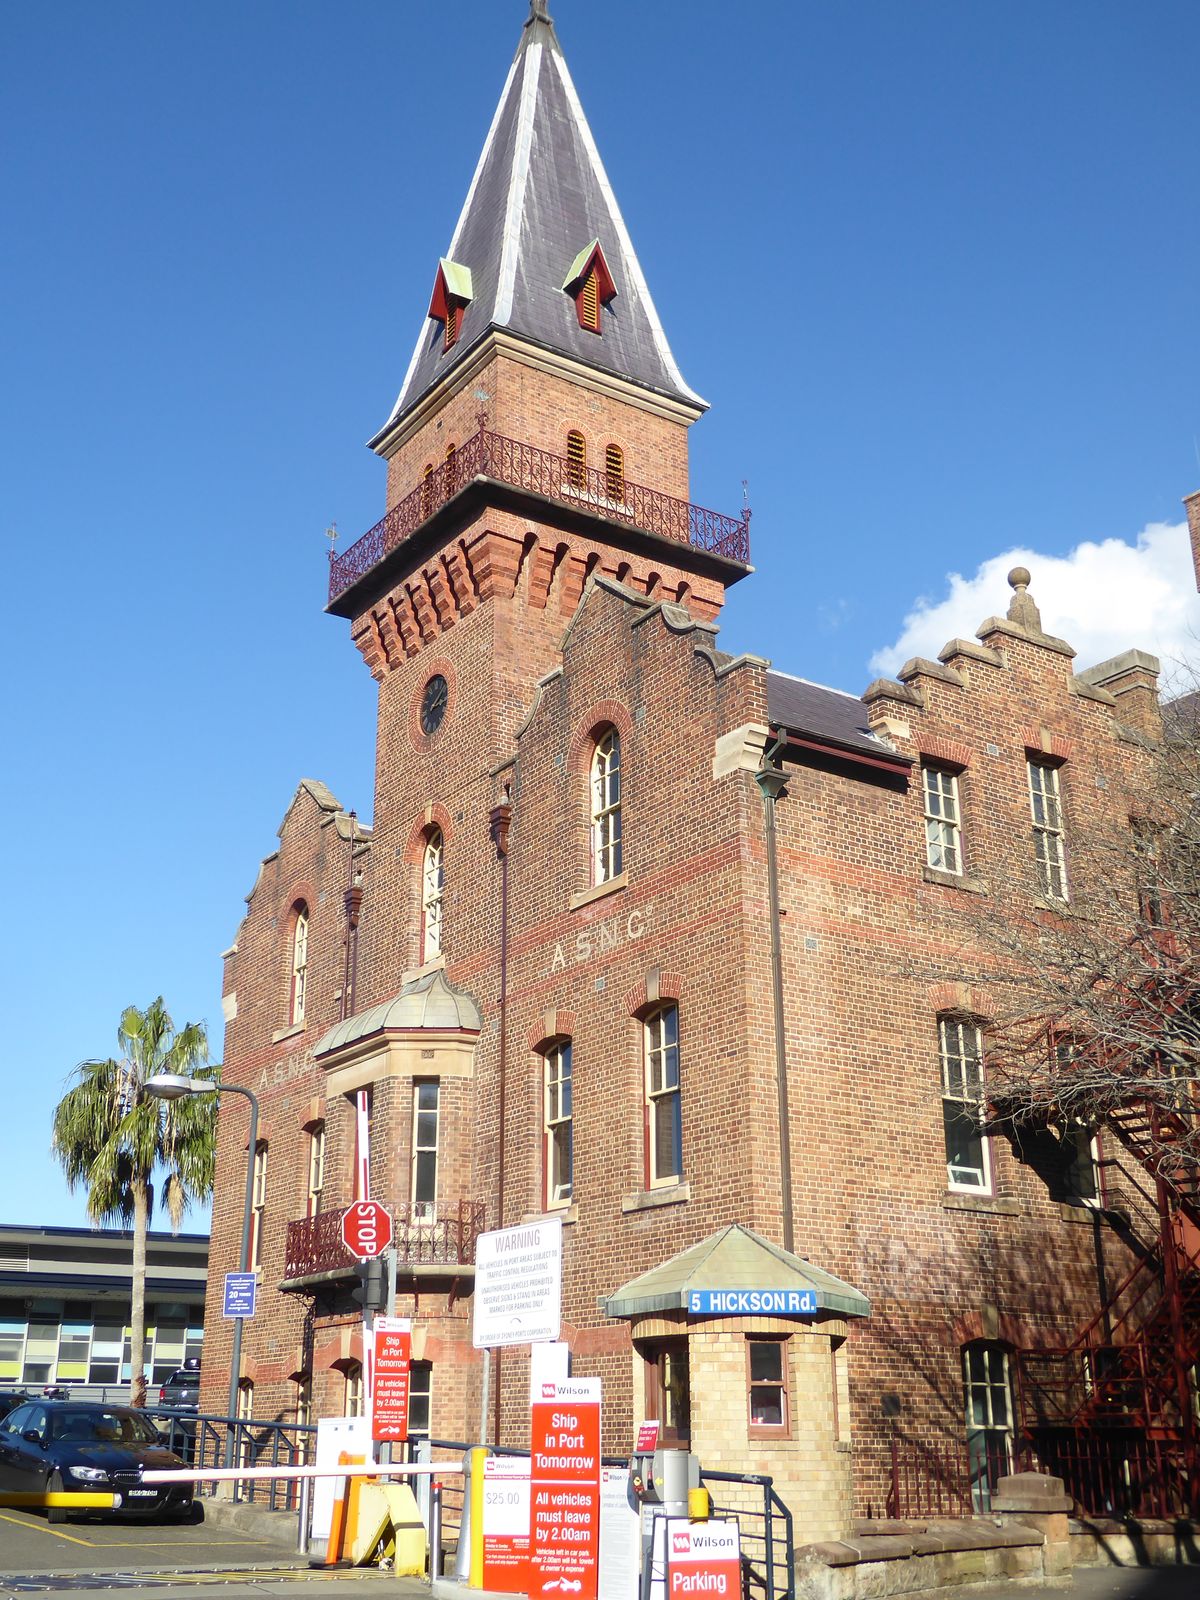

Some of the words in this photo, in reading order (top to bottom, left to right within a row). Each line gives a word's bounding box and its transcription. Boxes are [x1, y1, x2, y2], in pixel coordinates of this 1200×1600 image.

[357, 1205, 377, 1254] STOP
[495, 1229, 540, 1253] WARNING
[533, 1250, 551, 1261] SUBJECT
[228, 1291, 239, 1299] 20
[691, 1293, 701, 1311] 5
[709, 1292, 786, 1311] HICKSON
[788, 1293, 815, 1311] Rd.
[385, 1336, 400, 1346] Ship
[382, 1348, 388, 1356] in
[389, 1348, 403, 1357] Port
[377, 1358, 407, 1367] Tomorrow
[557, 1386, 590, 1395] Wilson
[377, 1399, 384, 1407] by
[384, 1399, 405, 1407] 2.00am
[551, 1413, 578, 1431] Ship
[544, 1433, 556, 1448] in
[559, 1433, 585, 1448] Port
[534, 1453, 594, 1469] Tomorrow
[486, 1492, 520, 1505] $25.00
[535, 1492, 549, 1505] All
[551, 1493, 592, 1506] vehicles
[536, 1510, 562, 1523] must
[564, 1510, 591, 1524] leave
[536, 1527, 549, 1542] by
[551, 1527, 591, 1541] 2.00am
[692, 1536, 734, 1548] Wilson
[672, 1570, 727, 1594] Parking
